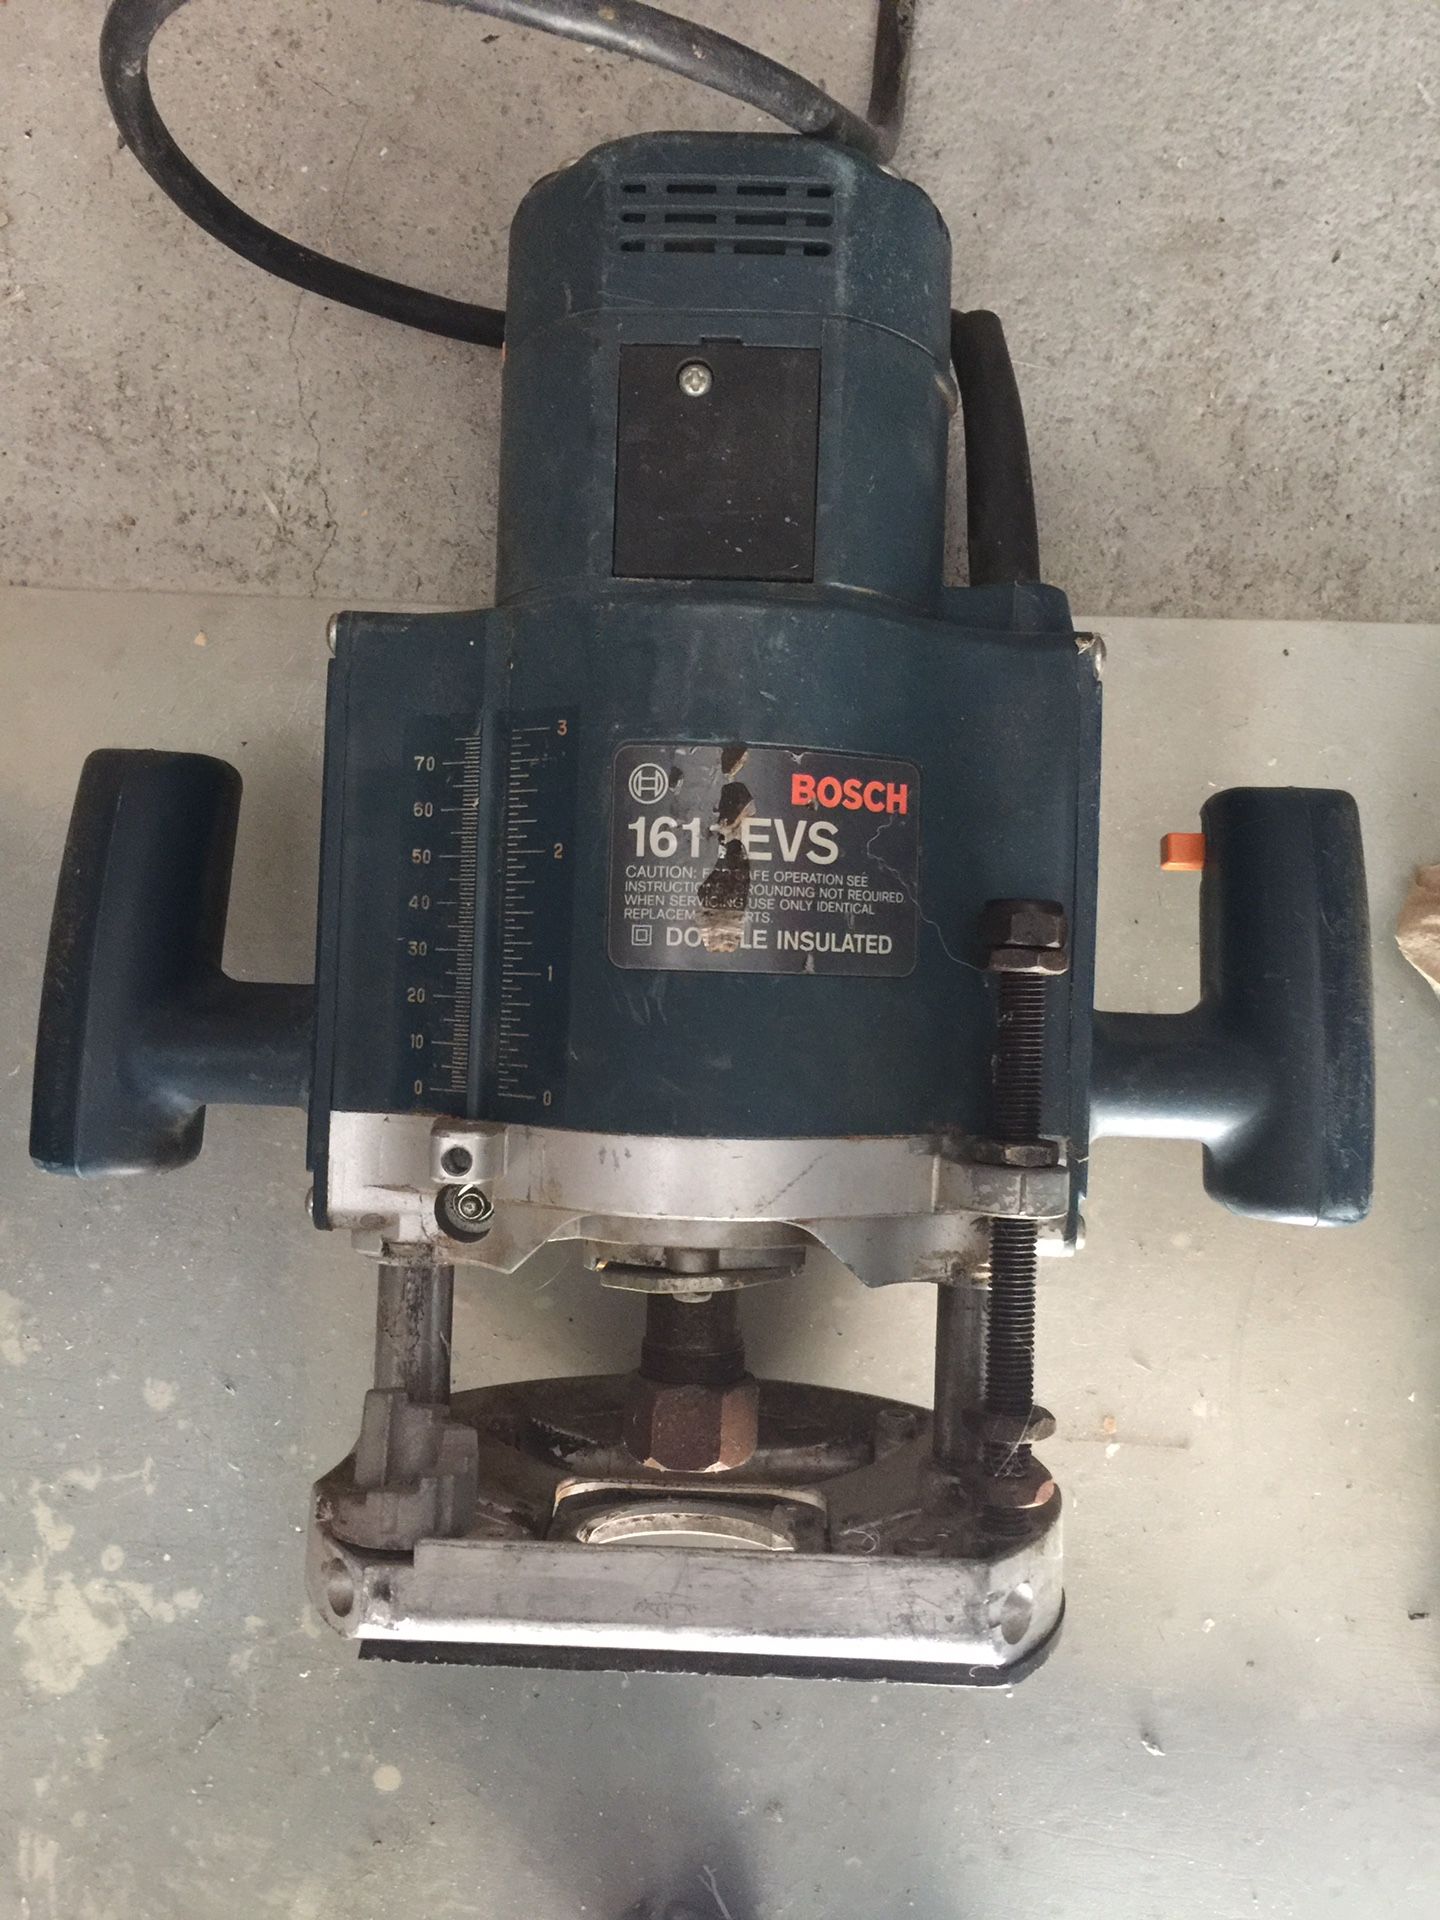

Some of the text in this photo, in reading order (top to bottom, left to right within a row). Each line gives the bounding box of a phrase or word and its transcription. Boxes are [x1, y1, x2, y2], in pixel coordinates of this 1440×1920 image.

[557, 720, 567, 735] 3
[414, 756, 435, 771] 70
[791, 773, 908, 815] BOSCH
[413, 802, 433, 817] 60
[411, 849, 431, 864] 50
[553, 843, 563, 858] 2
[626, 865, 697, 879] CAUTION:
[738, 869, 769, 882] FE
[774, 871, 844, 885] OPERATION
[846, 874, 869, 887] SEE
[625, 881, 733, 895] INSTRUCTIO
[819, 887, 844, 900] NOT
[848, 890, 905, 903] REQUIRED.
[409, 895, 430, 910] 40
[624, 894, 665, 907] WHEN
[748, 898, 774, 910] USE
[780, 899, 812, 912] ONLY
[817, 901, 875, 915] IDENTICAL
[624, 908, 708, 922] REPLACEM
[666, 927, 892, 954] DOLE INSULATED
[408, 941, 427, 956] 30
[547, 965, 553, 981] 1
[407, 988, 425, 1003] 20
[410, 1034, 424, 1049] 10
[414, 1081, 423, 1095] 0
[543, 1090, 552, 1106] 0
